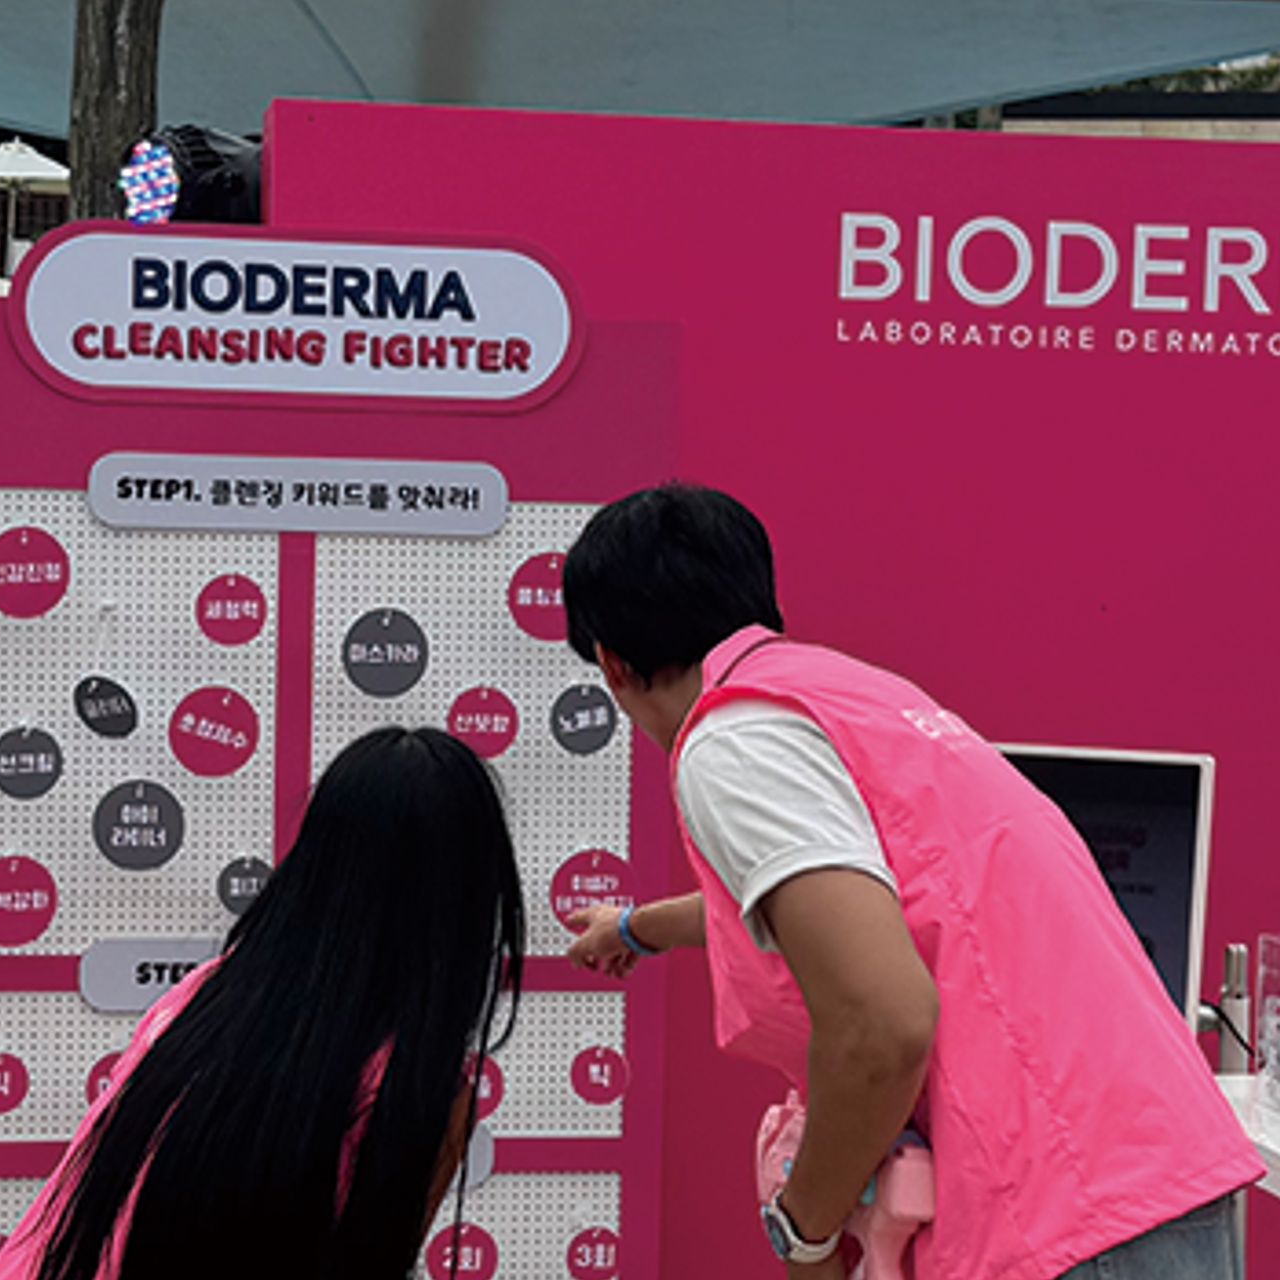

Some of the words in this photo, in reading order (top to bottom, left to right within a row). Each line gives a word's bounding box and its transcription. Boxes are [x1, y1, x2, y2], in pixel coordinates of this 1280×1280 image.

[131, 257, 475, 321] BIODERMA
[72, 322, 326, 367] CLEANSING
[343, 331, 532, 375] FIGHTER
[836, 320, 1097, 352] LABORATOIRE
[116, 476, 202, 502] STEP1.
[210, 478, 283, 510] 클렌징
[291, 480, 390, 511] 키워드를
